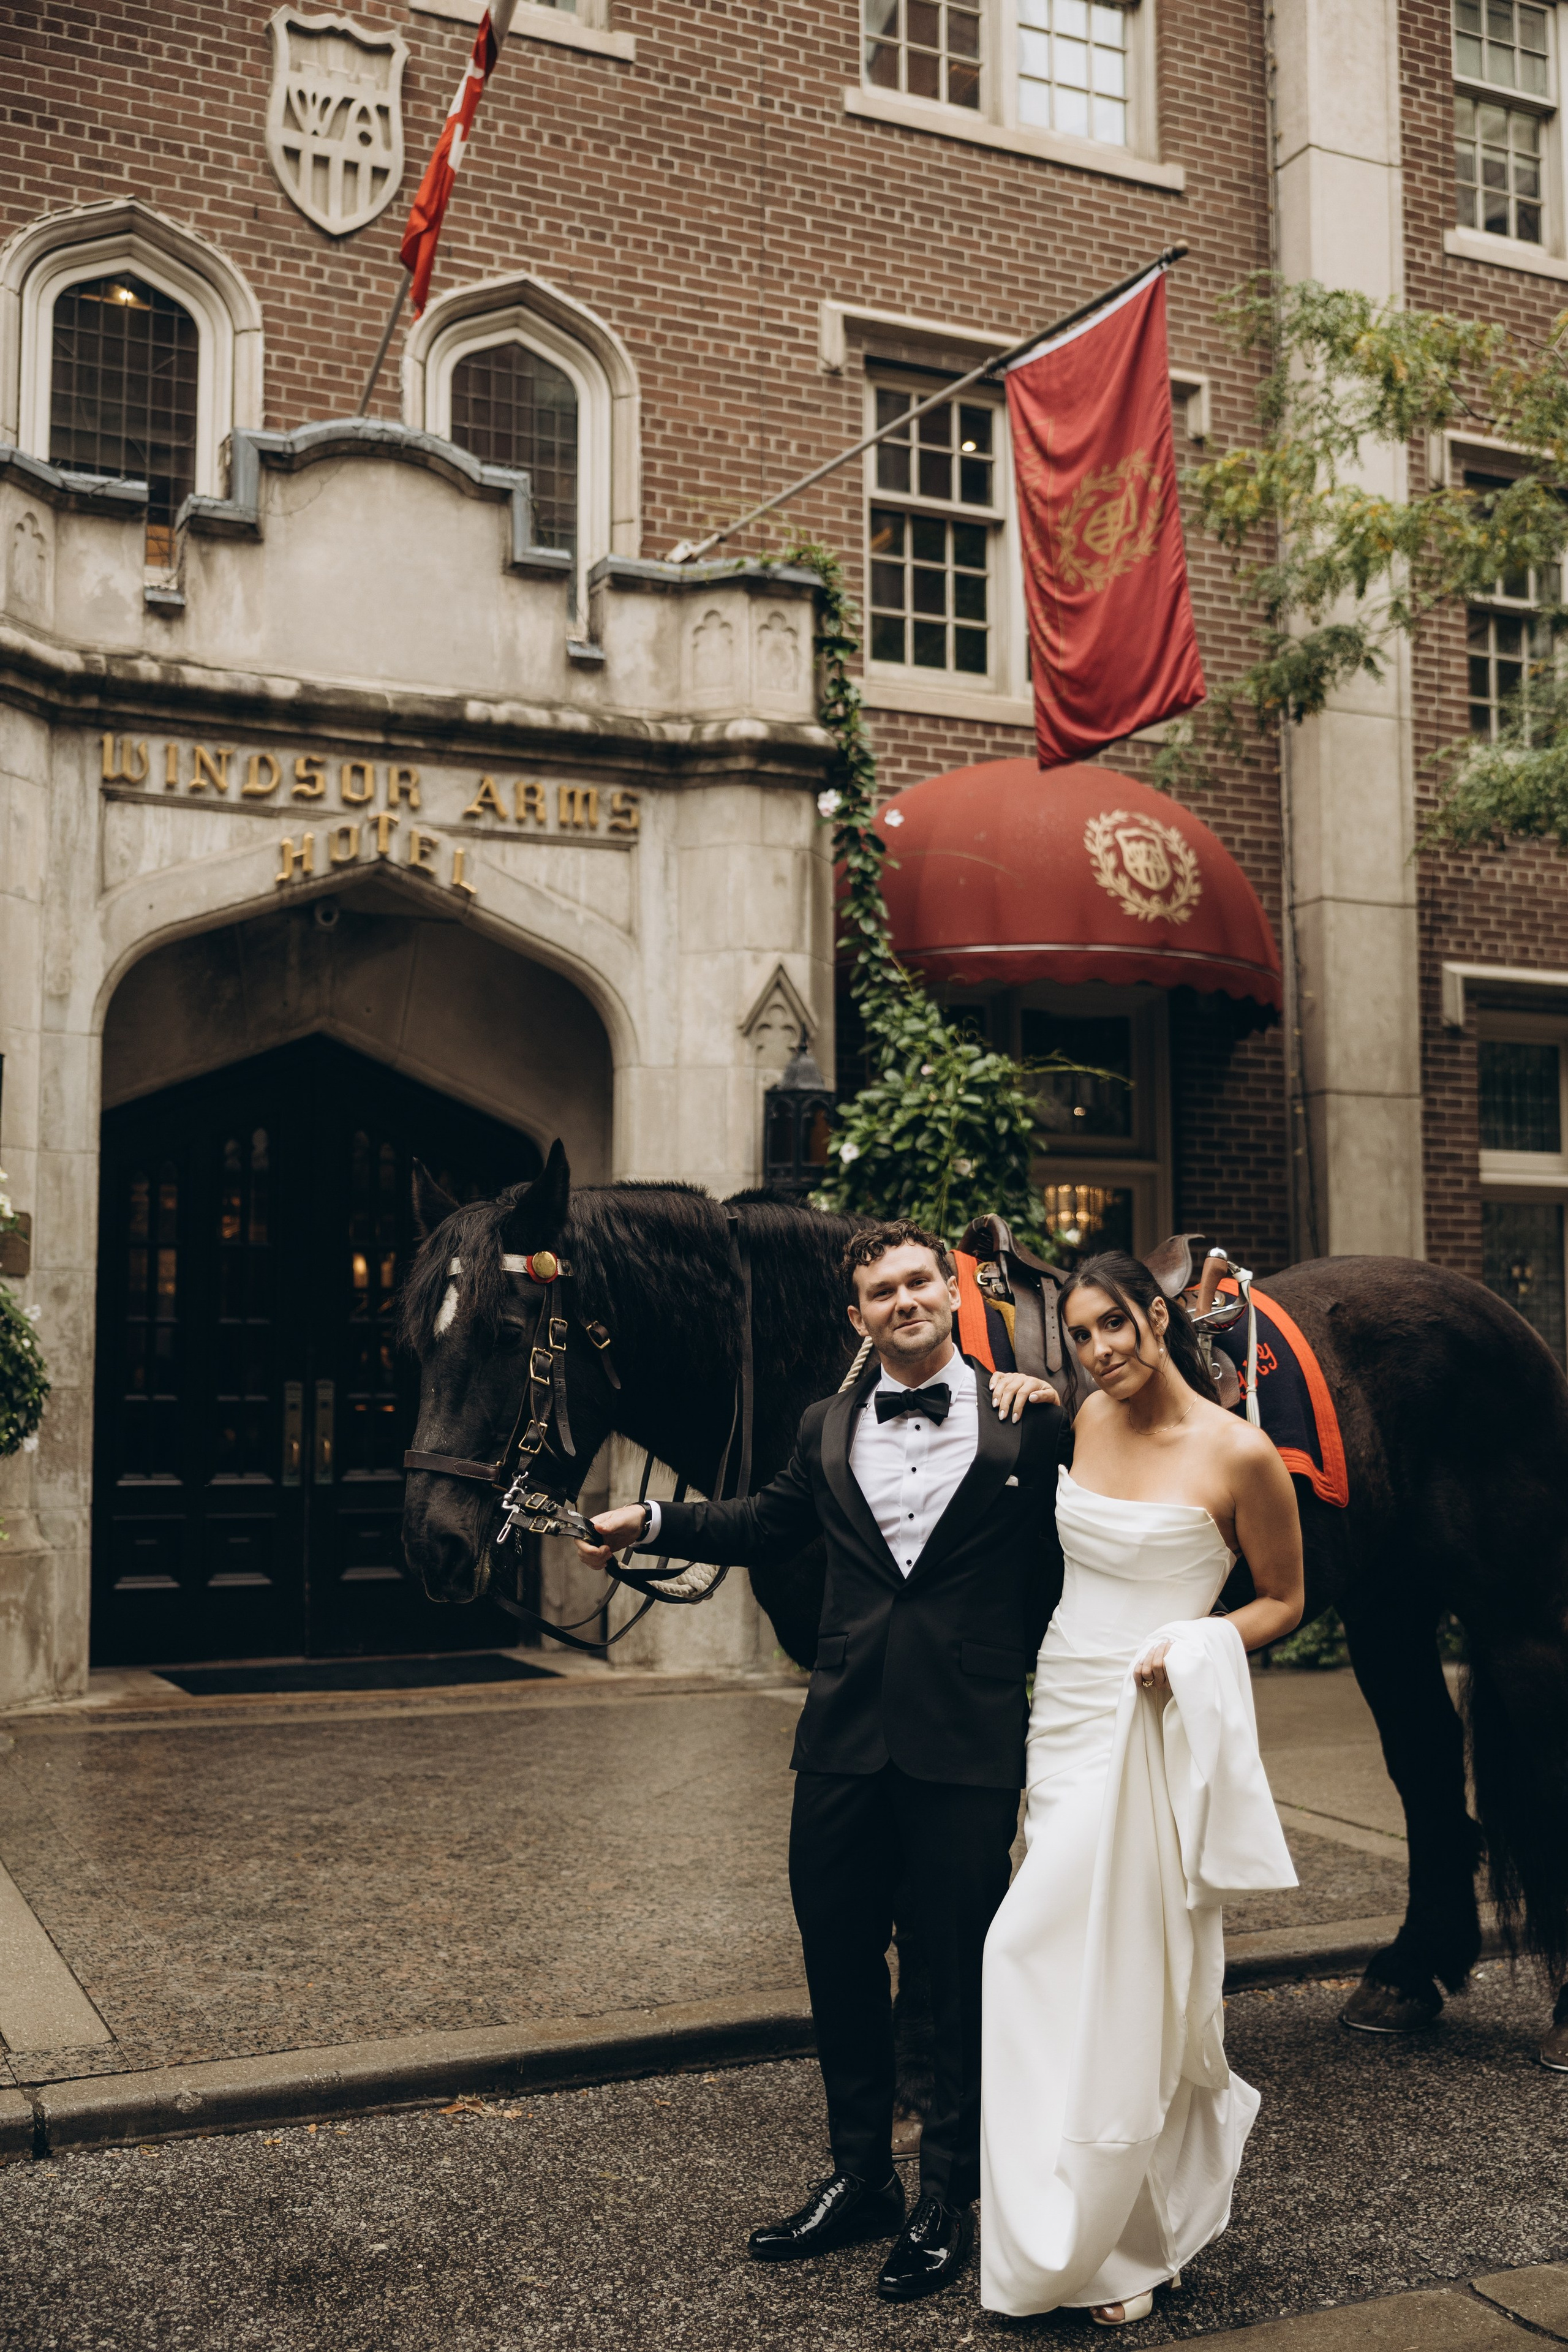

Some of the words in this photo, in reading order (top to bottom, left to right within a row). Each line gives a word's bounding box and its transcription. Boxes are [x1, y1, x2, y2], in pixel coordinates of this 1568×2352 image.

[102, 733, 422, 807] WINDSOR
[462, 774, 639, 828] ARMS
[276, 811, 477, 894] HOTEL
